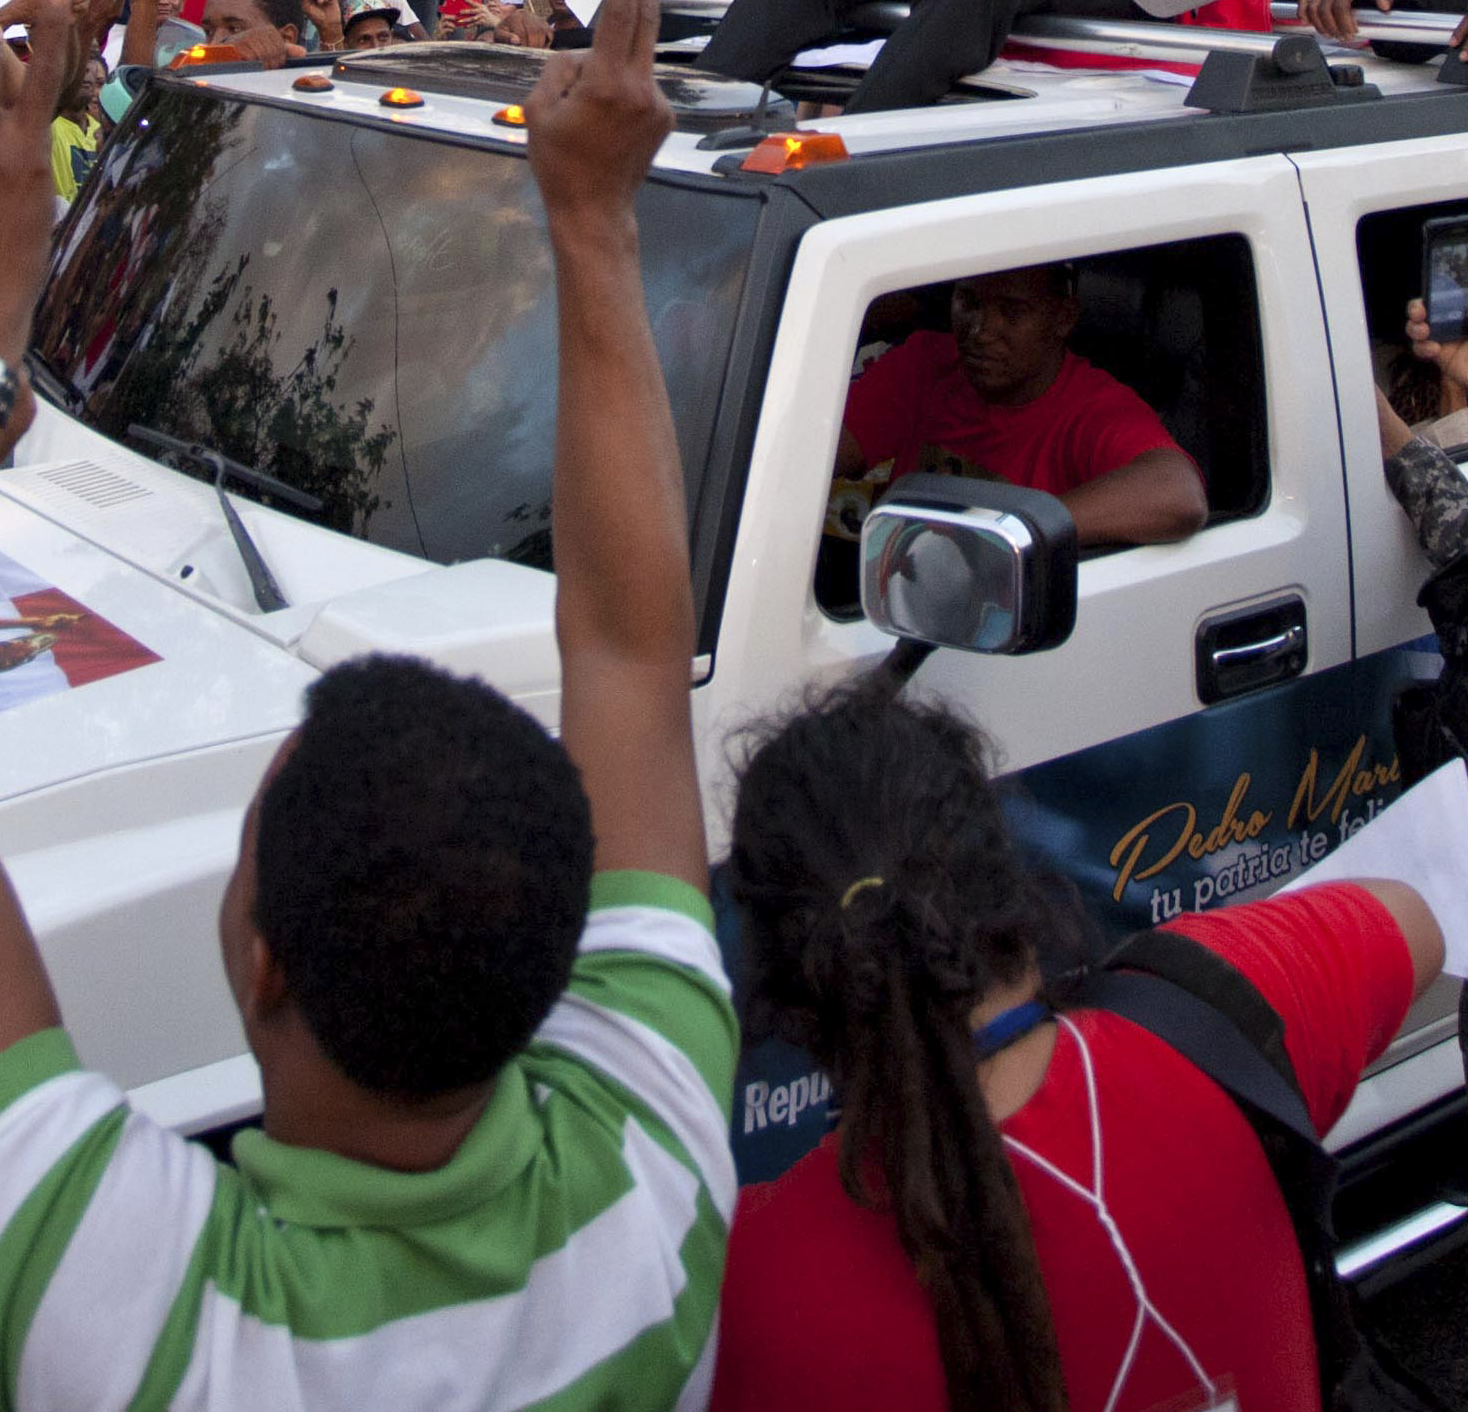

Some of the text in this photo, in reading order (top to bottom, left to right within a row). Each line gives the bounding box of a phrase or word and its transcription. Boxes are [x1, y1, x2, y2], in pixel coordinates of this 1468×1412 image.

[1110, 772, 1273, 903] Pedro
[1150, 888, 1182, 923] tu
[1193, 841, 1292, 913] patria
[1300, 830, 1328, 866] te
[744, 1071, 832, 1134] Repu
